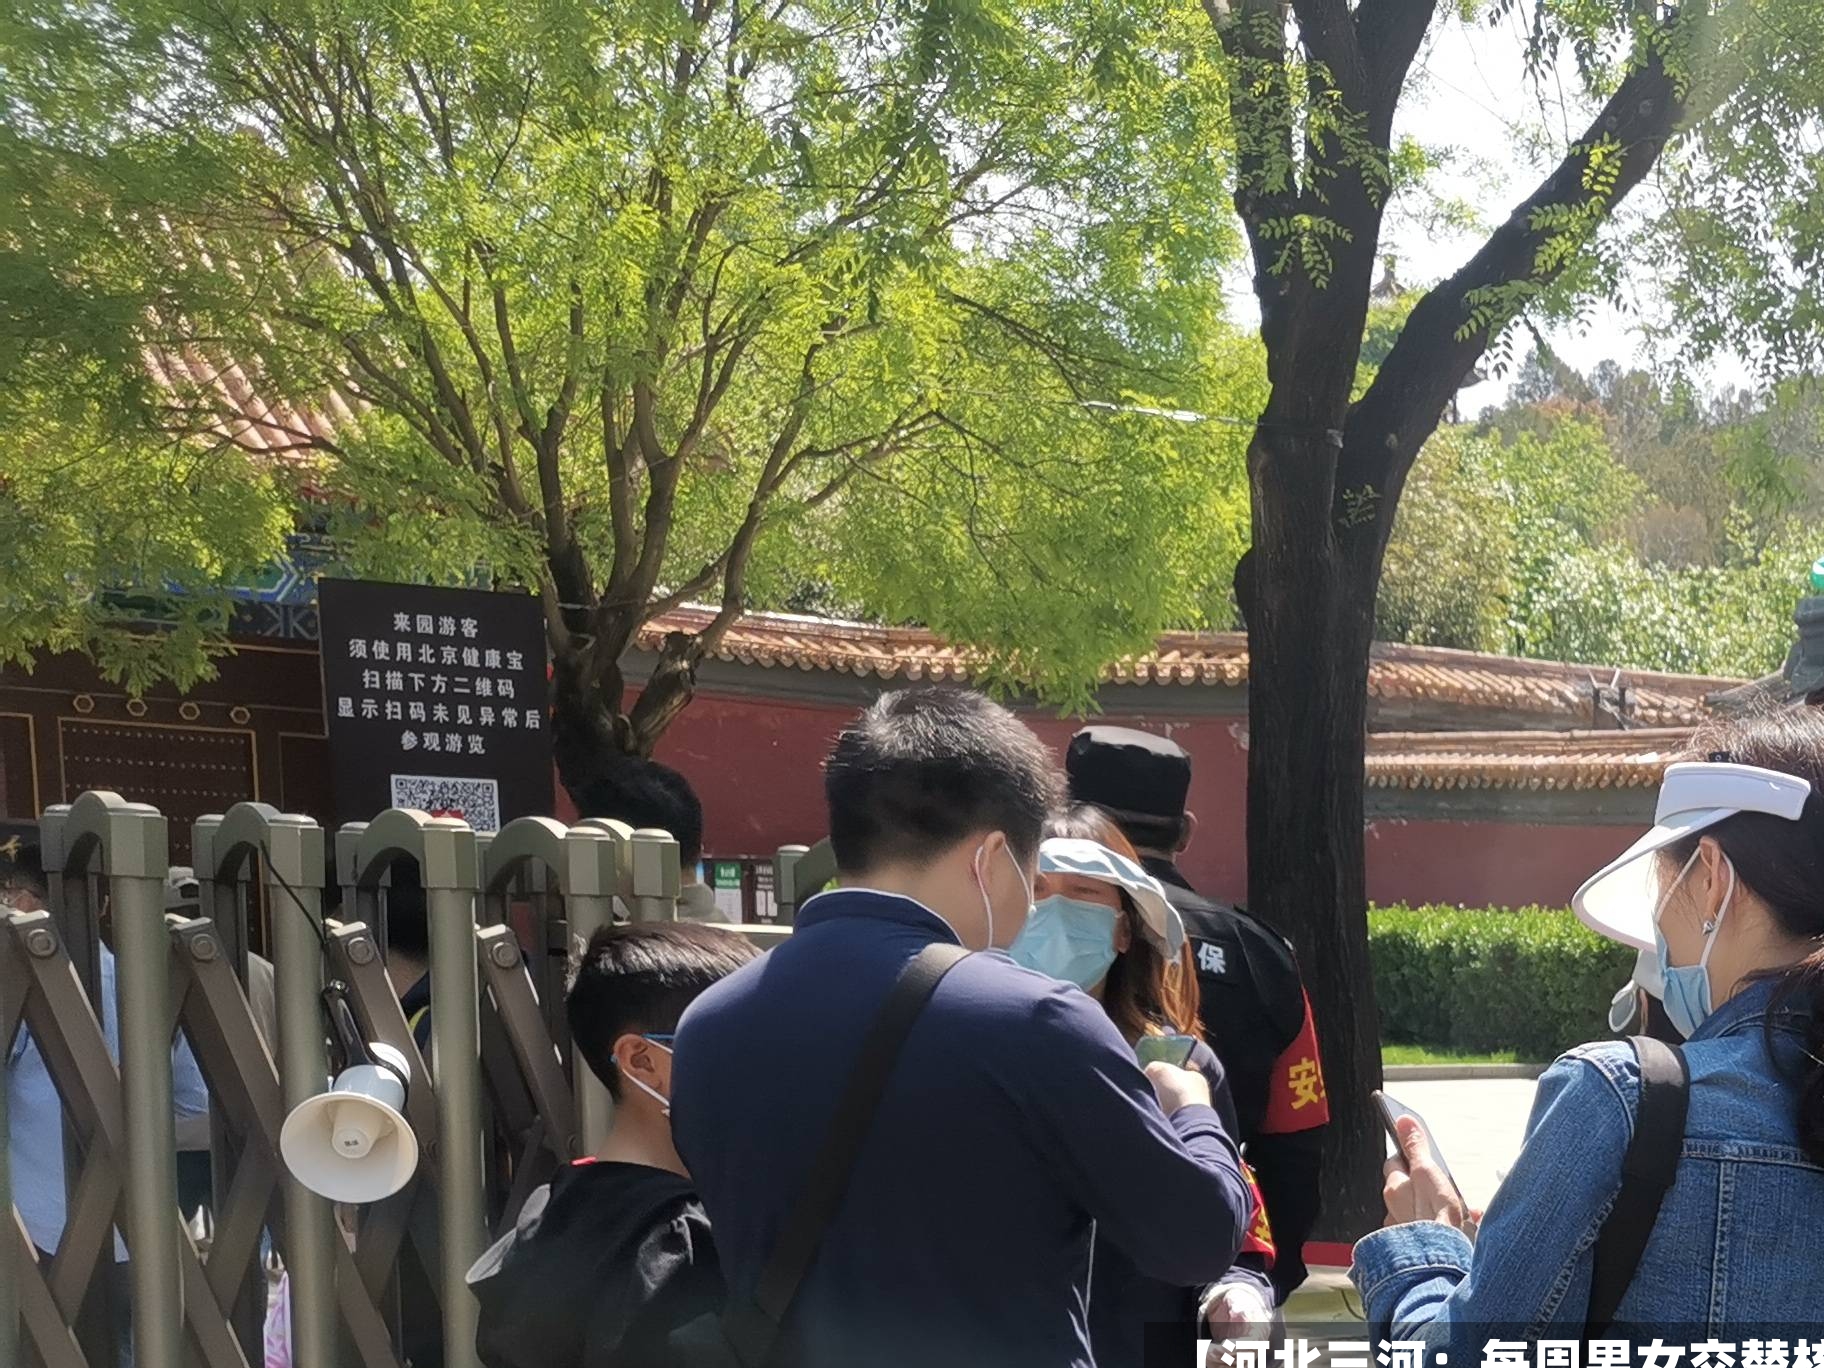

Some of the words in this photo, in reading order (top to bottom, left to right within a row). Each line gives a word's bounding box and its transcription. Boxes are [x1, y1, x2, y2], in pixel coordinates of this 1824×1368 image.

[393, 612, 479, 638] 来园游客
[349, 638, 523, 671] 须使用北京健康宝
[362, 668, 515, 699] 扫描下方二维码
[337, 697, 541, 729] 显示扫码未见异常后
[400, 730, 486, 754] 参观游览
[1197, 941, 1226, 974] 保
[1288, 1057, 1326, 1110] 安
